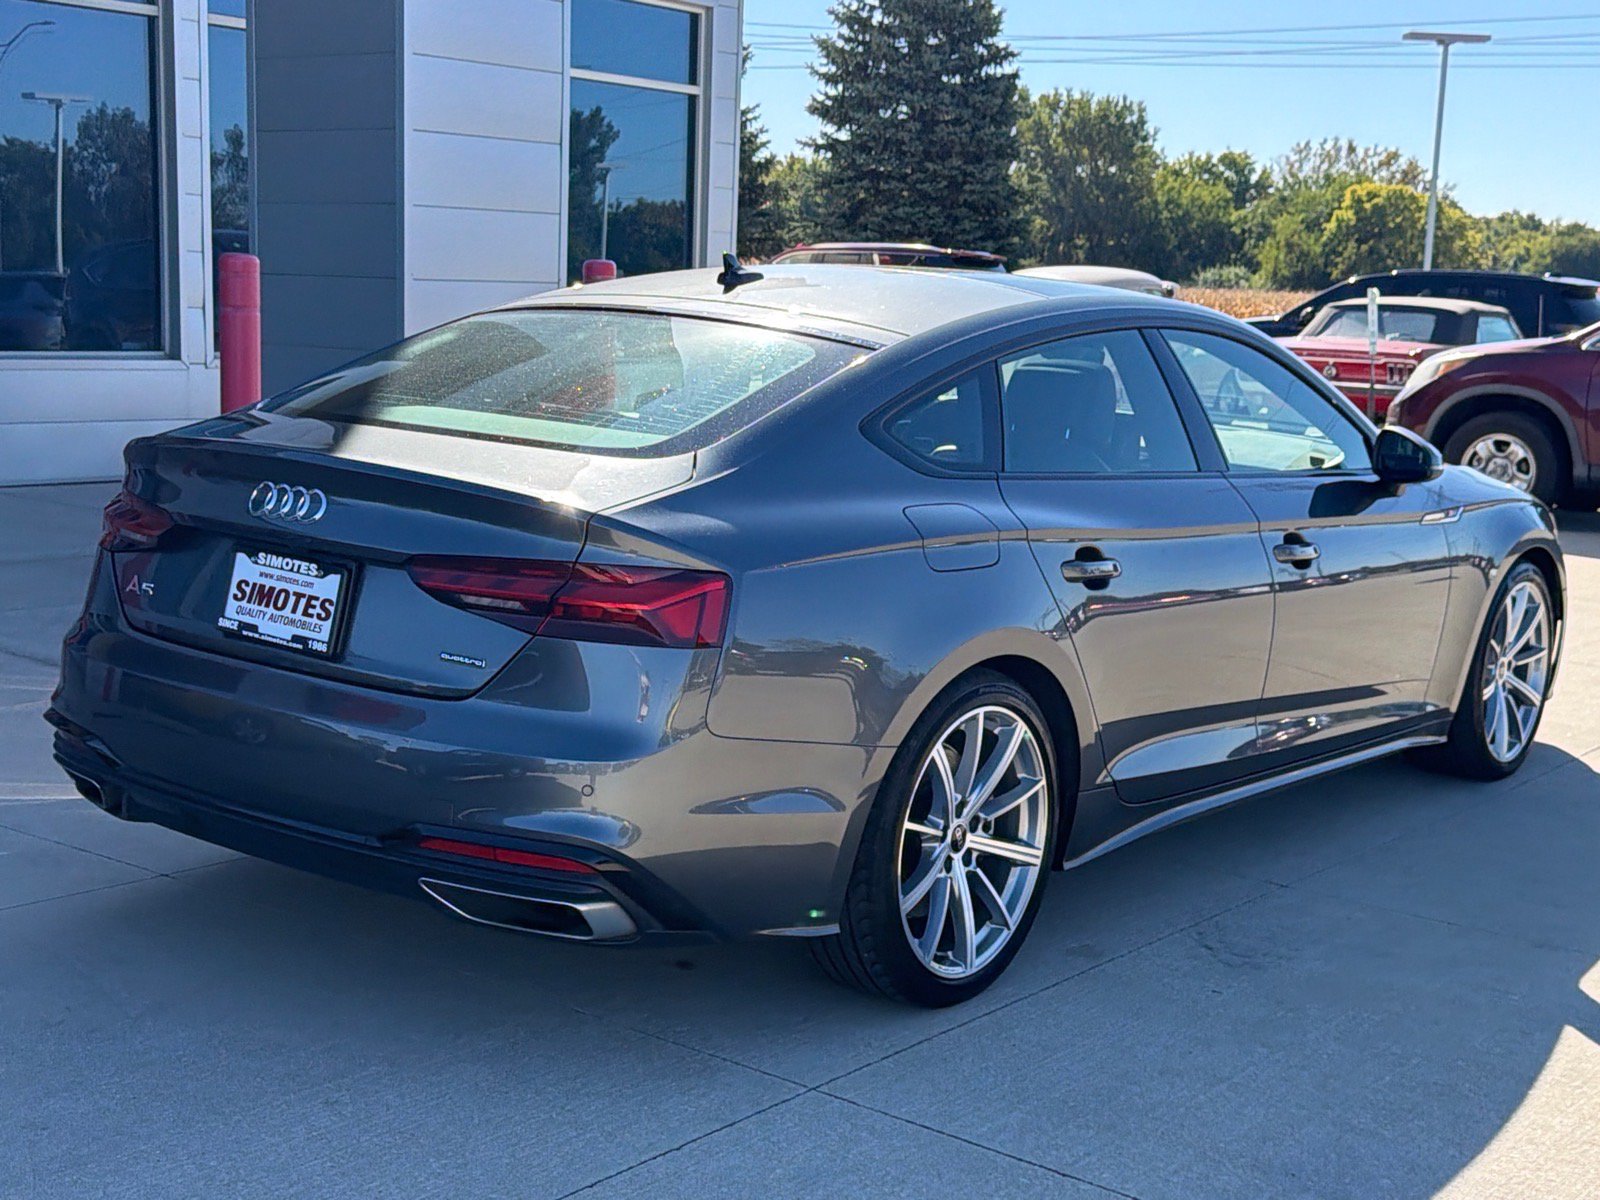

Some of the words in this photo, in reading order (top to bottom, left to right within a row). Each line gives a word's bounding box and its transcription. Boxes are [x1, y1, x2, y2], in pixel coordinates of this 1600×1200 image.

[257, 552, 319, 576] SIMOTES
[126, 574, 155, 595] A5
[232, 579, 335, 621] SIMOTES
[217, 617, 239, 631] SINCE
[235, 605, 268, 620] QUALITY
[267, 612, 323, 634] AUTOMOBILES
[440, 653, 483, 666] quattro
